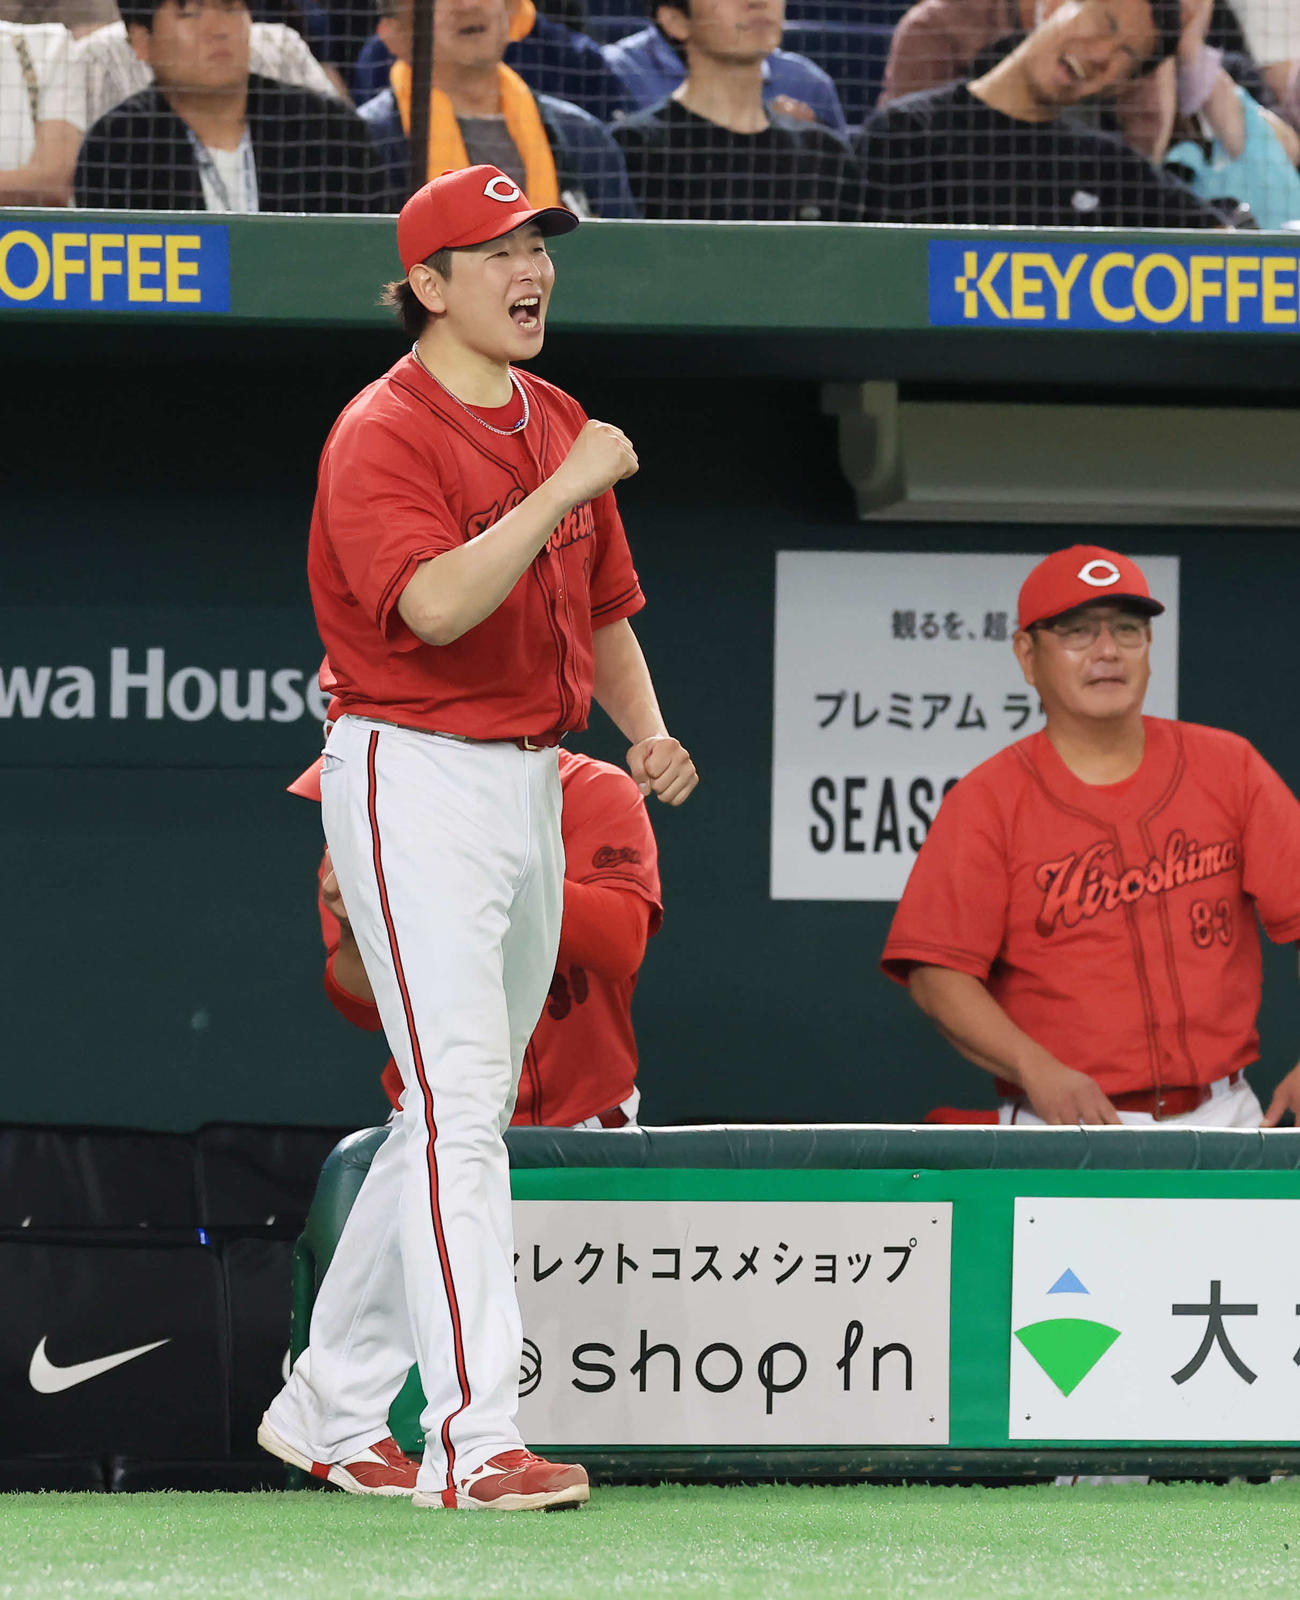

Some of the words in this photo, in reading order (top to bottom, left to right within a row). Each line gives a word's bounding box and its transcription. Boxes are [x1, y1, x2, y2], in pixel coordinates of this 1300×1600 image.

[0, 230, 201, 303] OFFEE
[955, 251, 1300, 324] KEYCOFFE
[892, 610, 1018, 641] 観るを、超
[1003, 693, 1047, 731] ラ
[810, 776, 960, 854] SEAS
[1034, 829, 1237, 938] Hiroshima
[1191, 899, 1233, 948] 83
[514, 1237, 918, 1285] レクトコスメショップ
[1170, 1279, 1300, 1385] 大
[571, 1329, 807, 1415] shop
